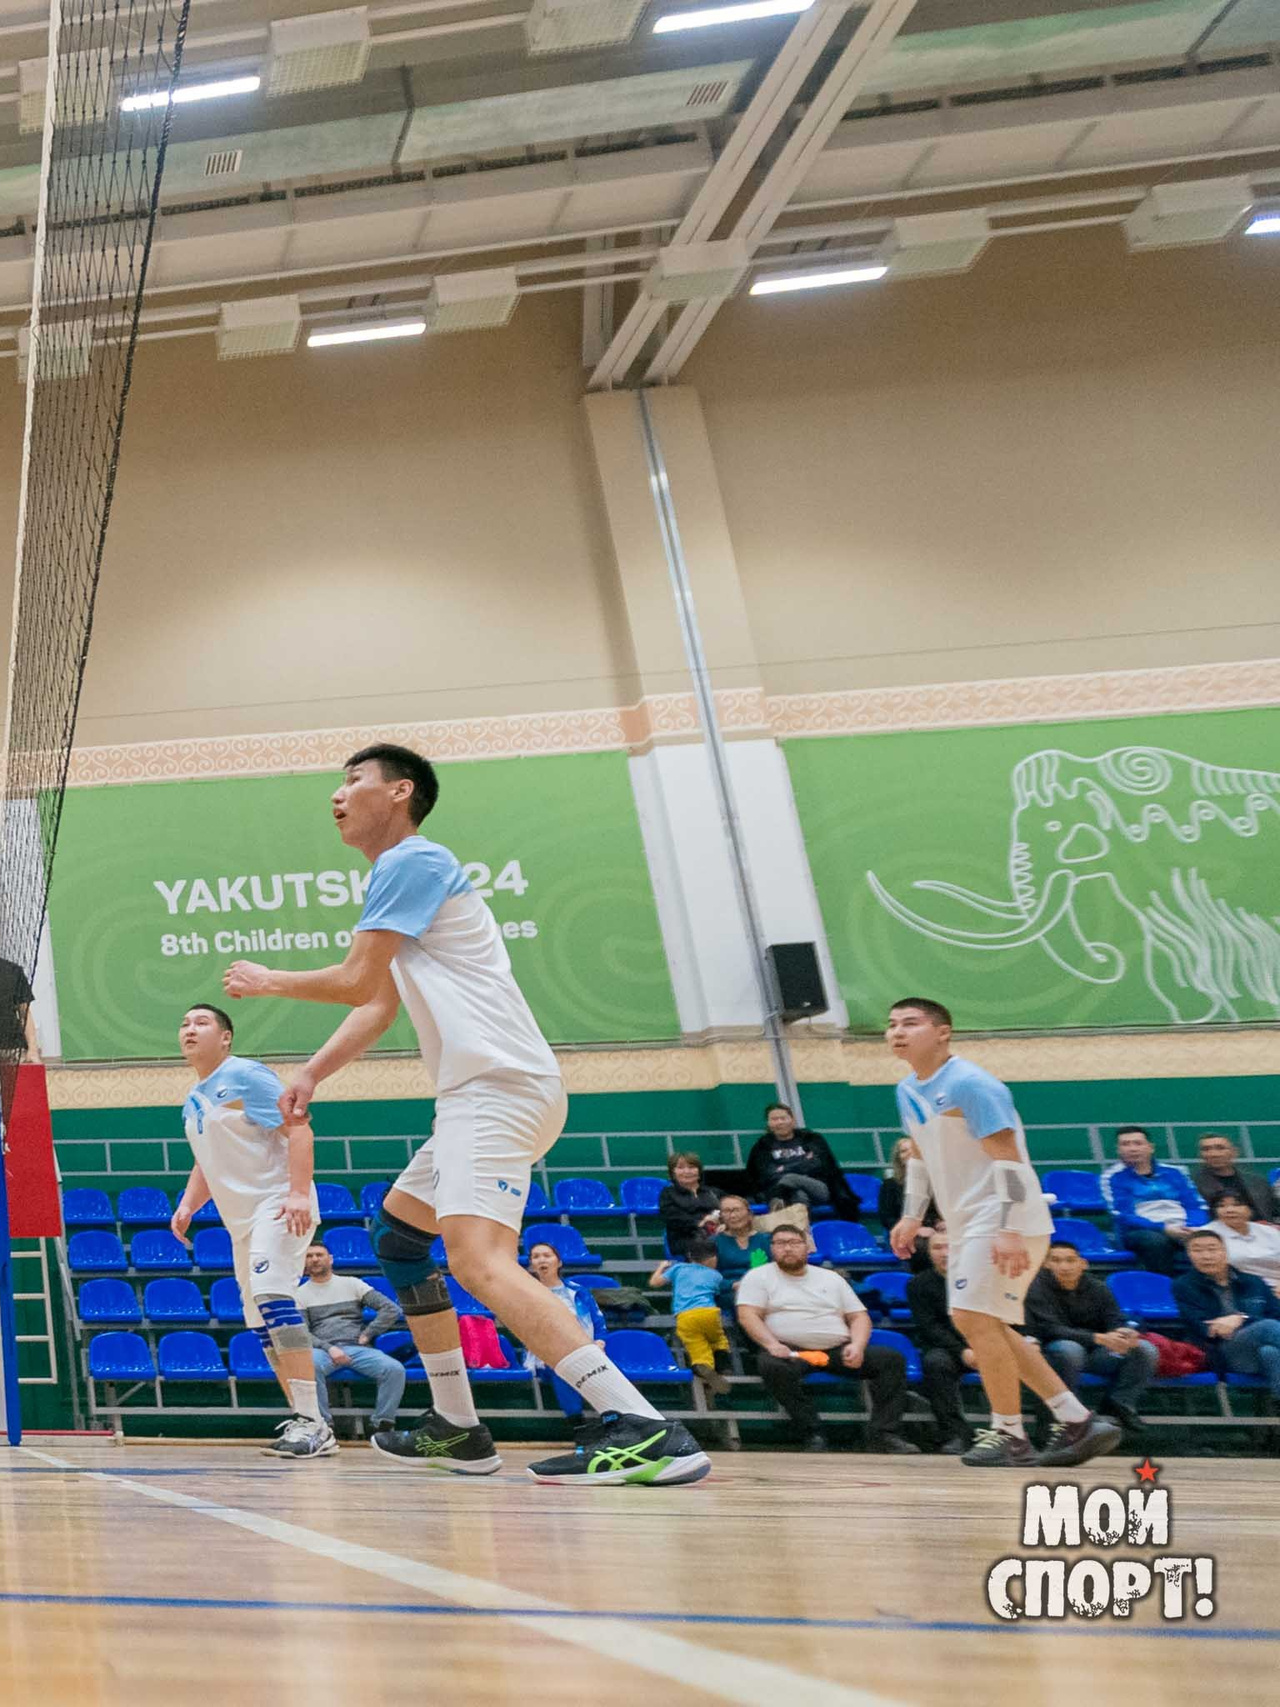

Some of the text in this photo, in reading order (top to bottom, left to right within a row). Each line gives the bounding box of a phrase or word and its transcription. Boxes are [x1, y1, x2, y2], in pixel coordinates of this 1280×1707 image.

[153, 860, 529, 914] YAKUTSK 24
[160, 931, 208, 956] 8th
[214, 928, 328, 952] Children
[575, 1364, 609, 1388] DEMIX
